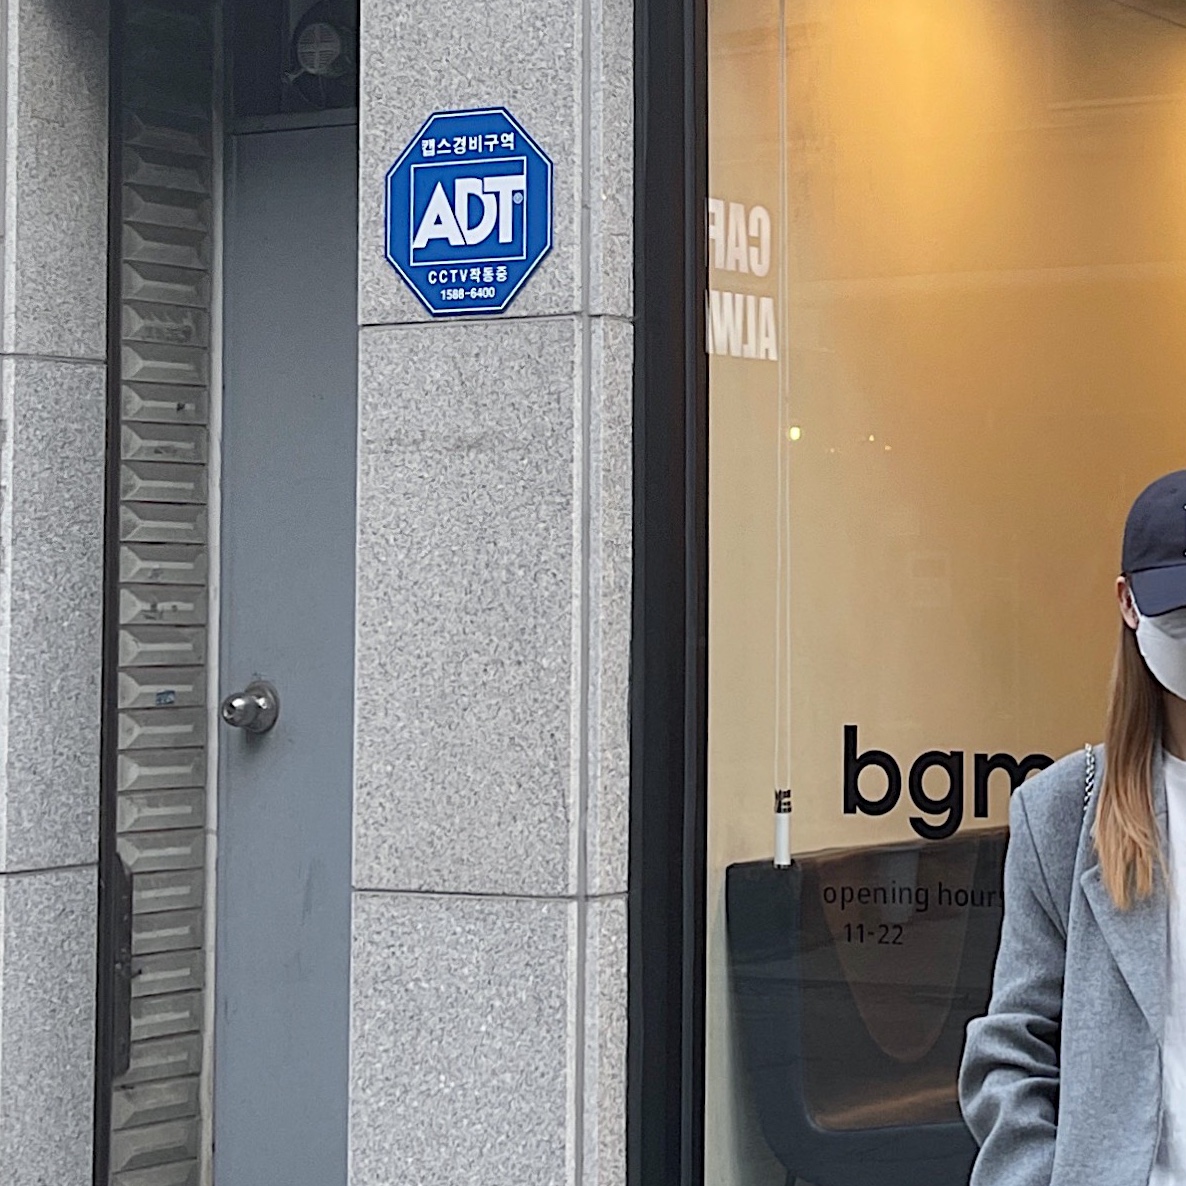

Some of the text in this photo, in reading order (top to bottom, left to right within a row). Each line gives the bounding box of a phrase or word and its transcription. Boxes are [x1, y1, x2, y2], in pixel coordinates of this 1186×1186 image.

[421, 133, 514, 157] 캡스경비구역
[412, 174, 525, 250] ADT
[440, 287, 496, 301] 1588-6400
[823, 880, 1004, 912] opening hour
[843, 923, 904, 945] 11-22
